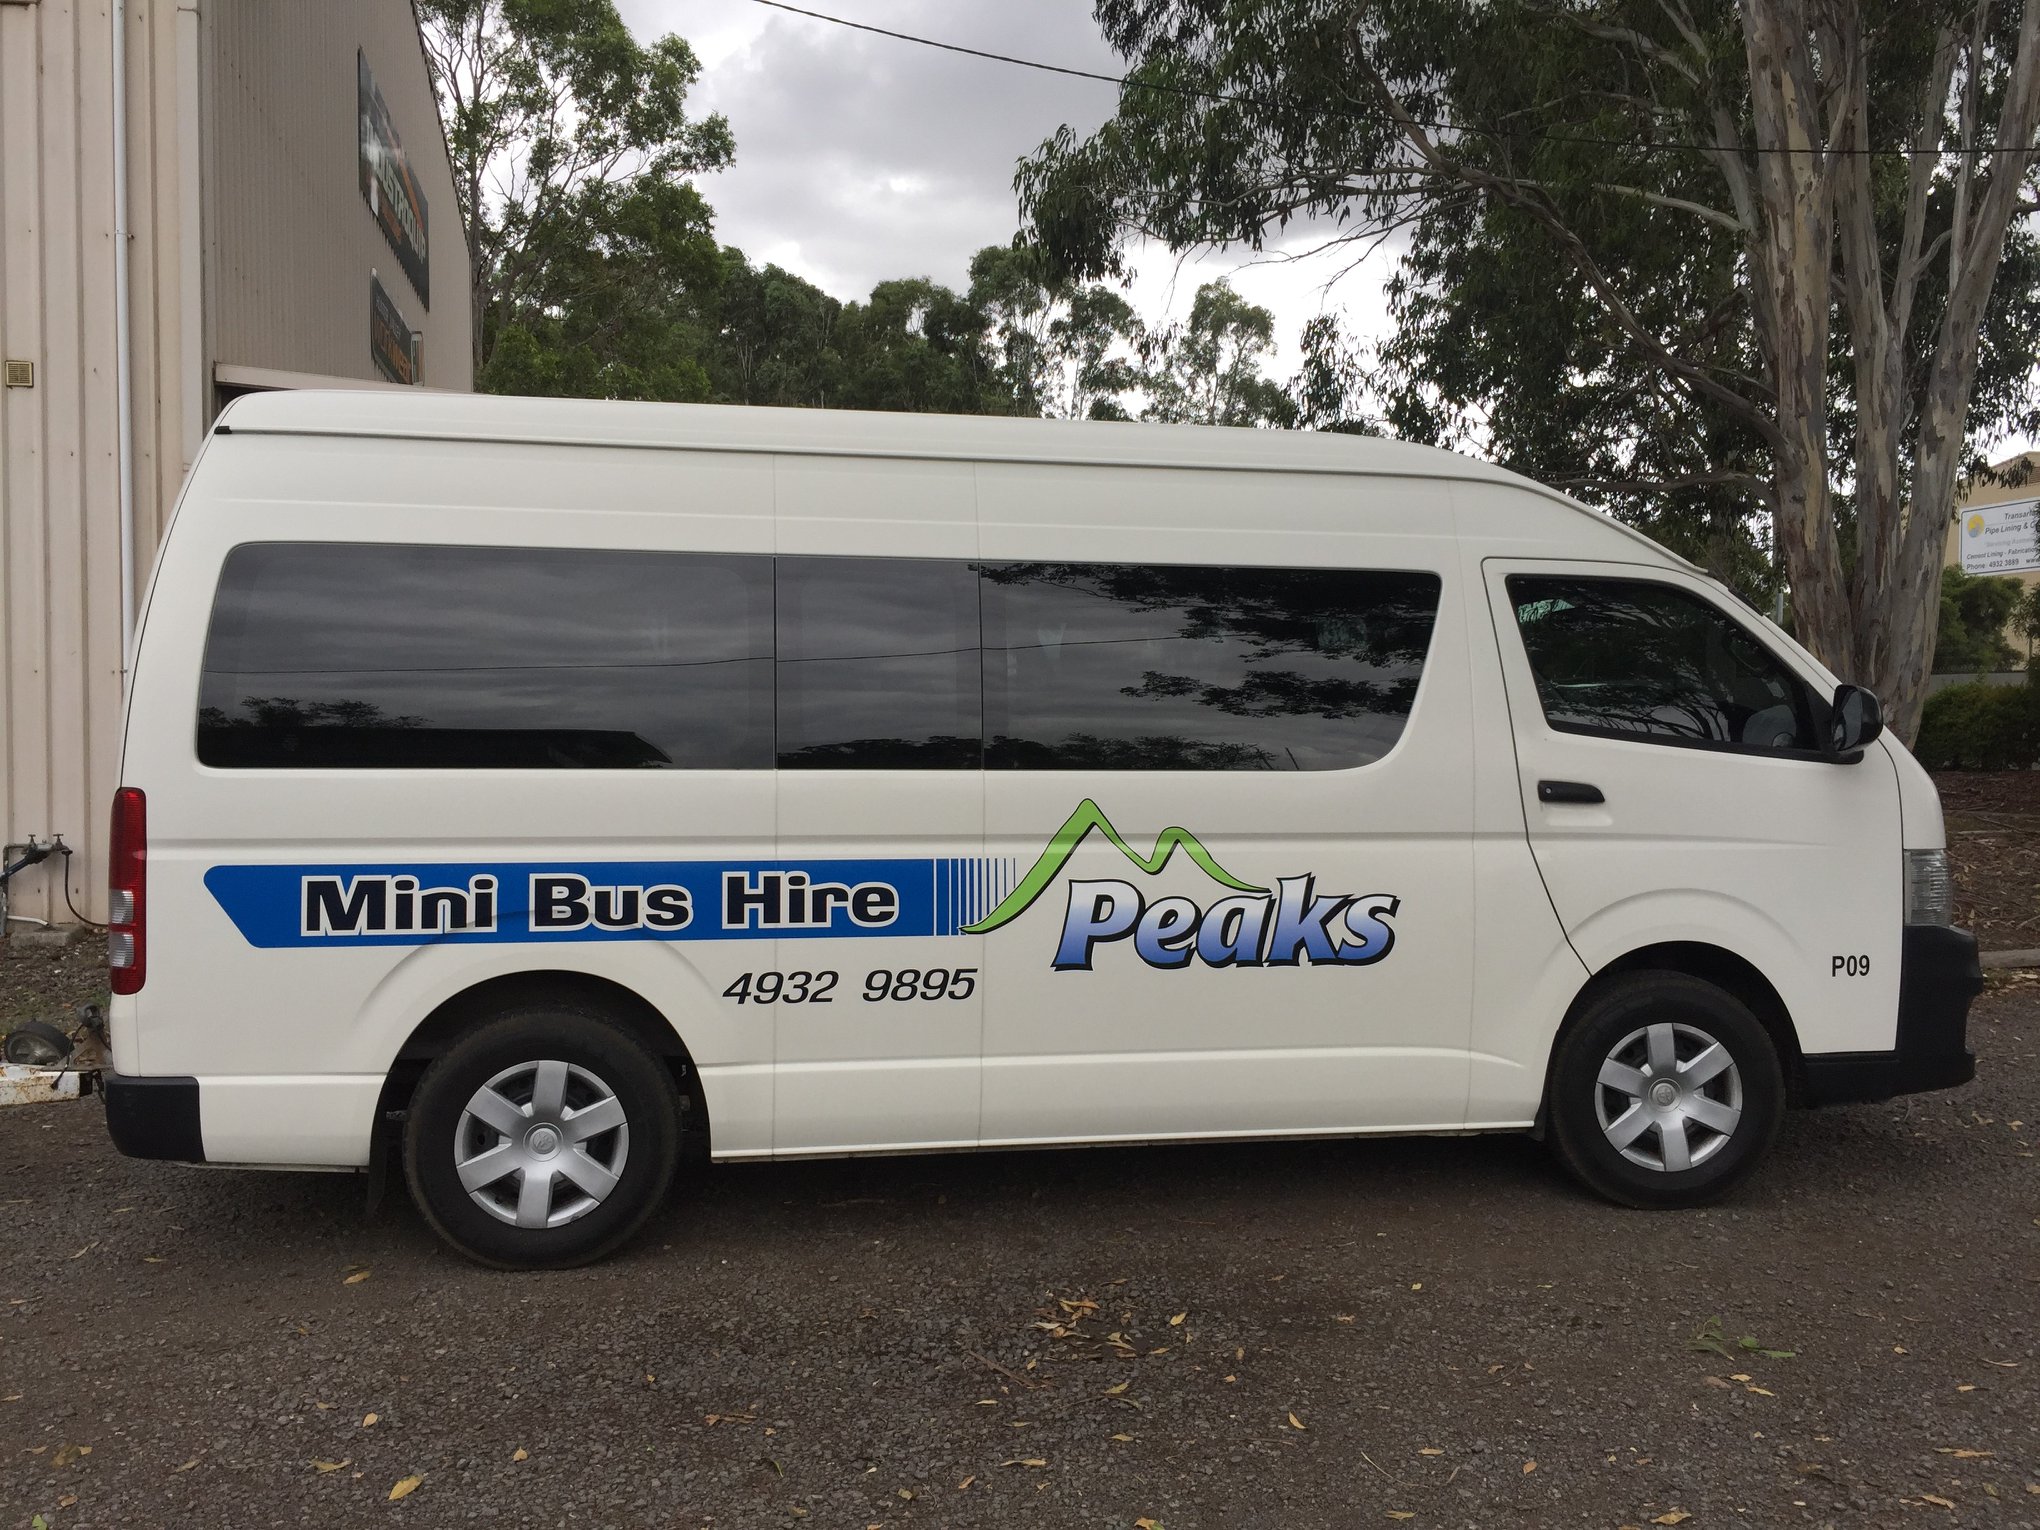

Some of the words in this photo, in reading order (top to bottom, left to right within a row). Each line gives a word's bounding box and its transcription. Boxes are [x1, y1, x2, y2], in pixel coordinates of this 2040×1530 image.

[2001, 524, 2022, 533] Lining
[302, 874, 497, 936] Mini
[529, 873, 694, 931] Bus
[722, 870, 900, 930] Hire
[1051, 872, 1400, 971] Peaks
[1832, 955, 1870, 977] P09
[722, 970, 838, 1005] 4932
[862, 968, 978, 1002] 9895
